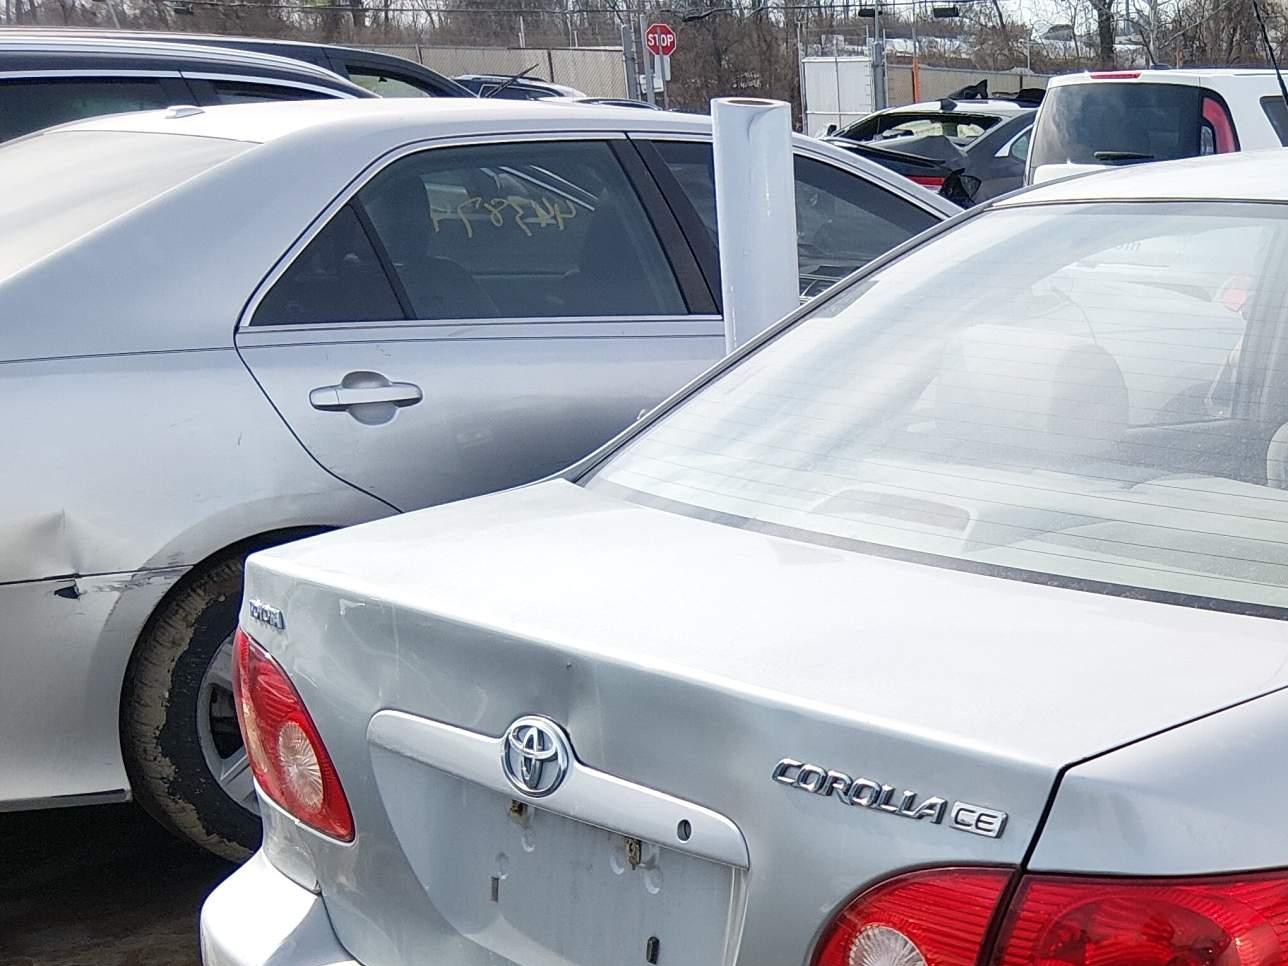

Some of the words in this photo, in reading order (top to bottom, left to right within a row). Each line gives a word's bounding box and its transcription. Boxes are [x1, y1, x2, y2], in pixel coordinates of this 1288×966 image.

[648, 34, 674, 47] STOP
[772, 758, 948, 825] COROLLA
[952, 804, 1003, 836] CE
